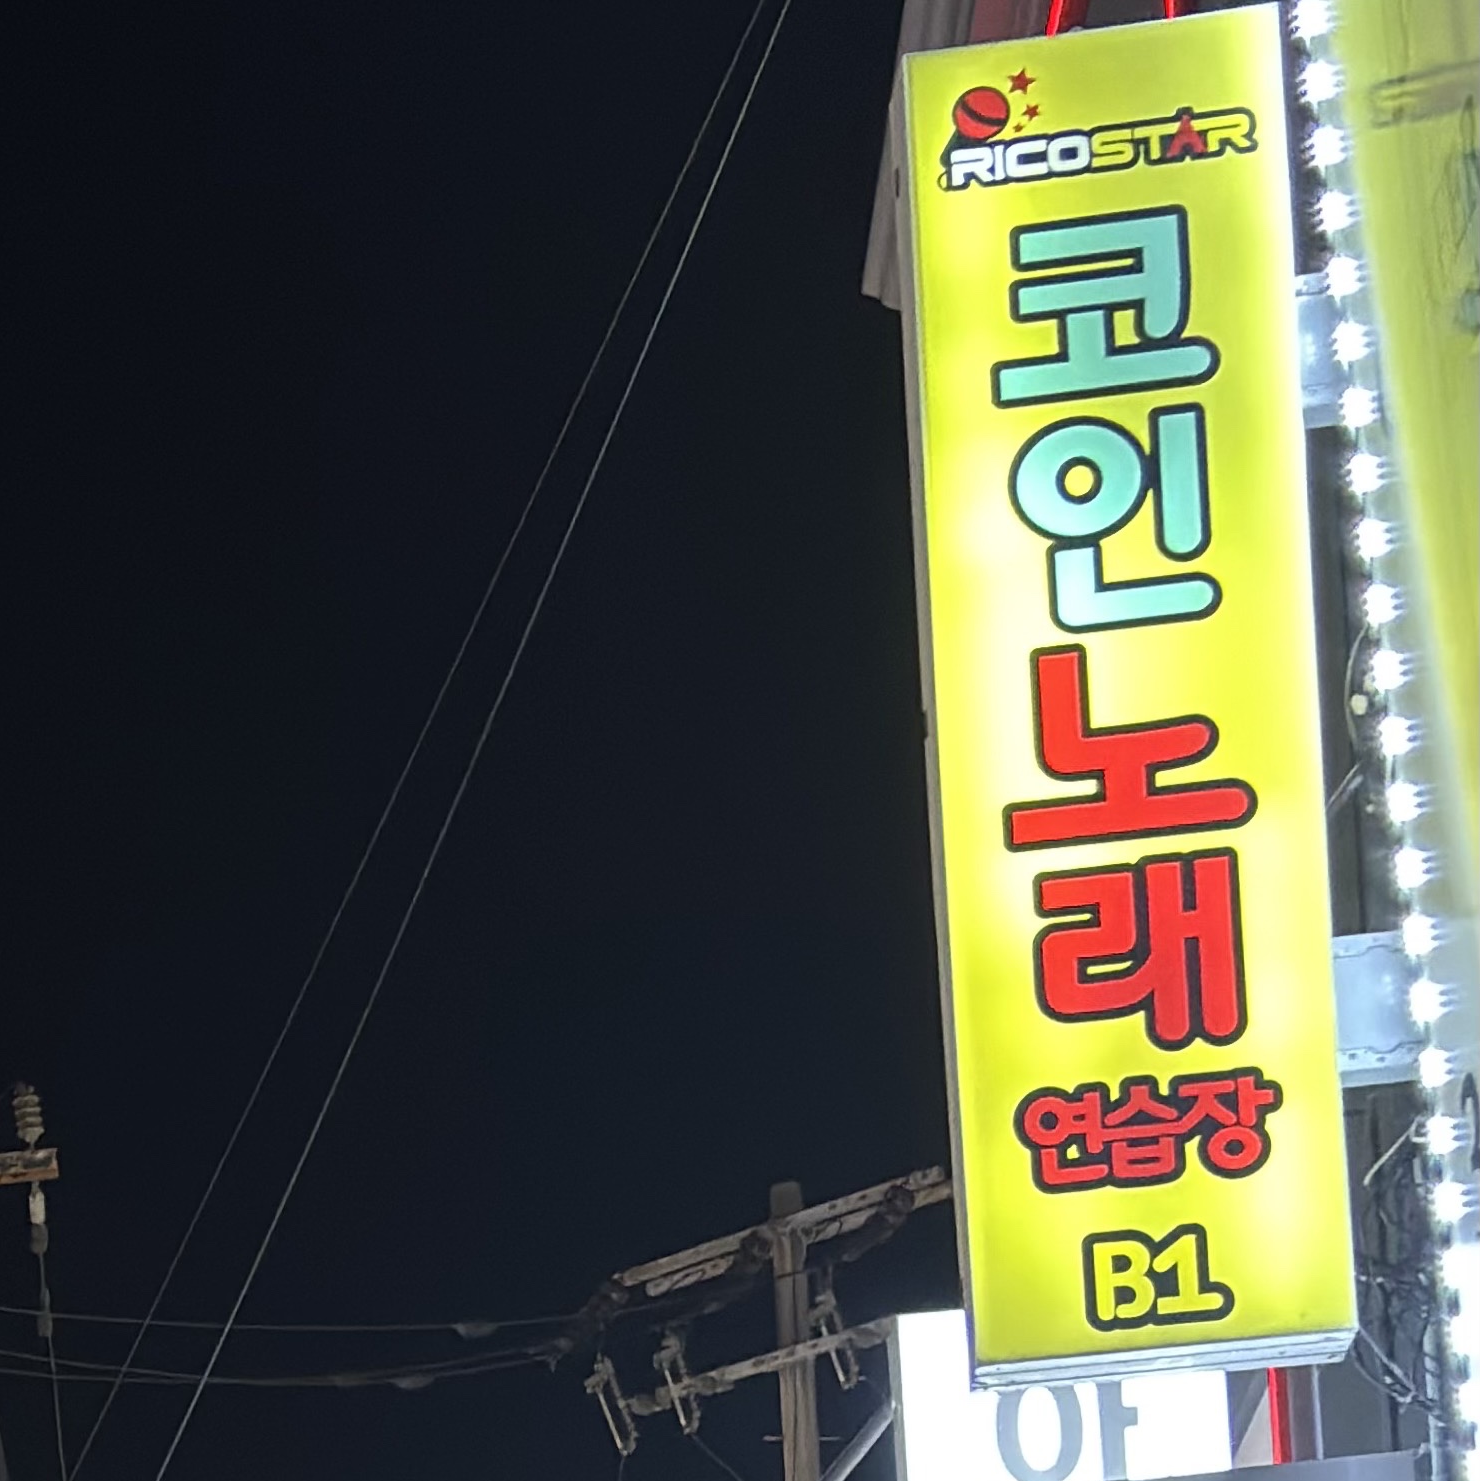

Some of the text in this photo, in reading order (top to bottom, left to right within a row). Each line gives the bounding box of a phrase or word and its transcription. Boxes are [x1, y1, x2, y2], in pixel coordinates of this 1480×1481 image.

[945, 107, 1257, 190] RICOSTAR
[1014, 1066, 1284, 1194] 연습장
[1081, 1223, 1235, 1332] B1
